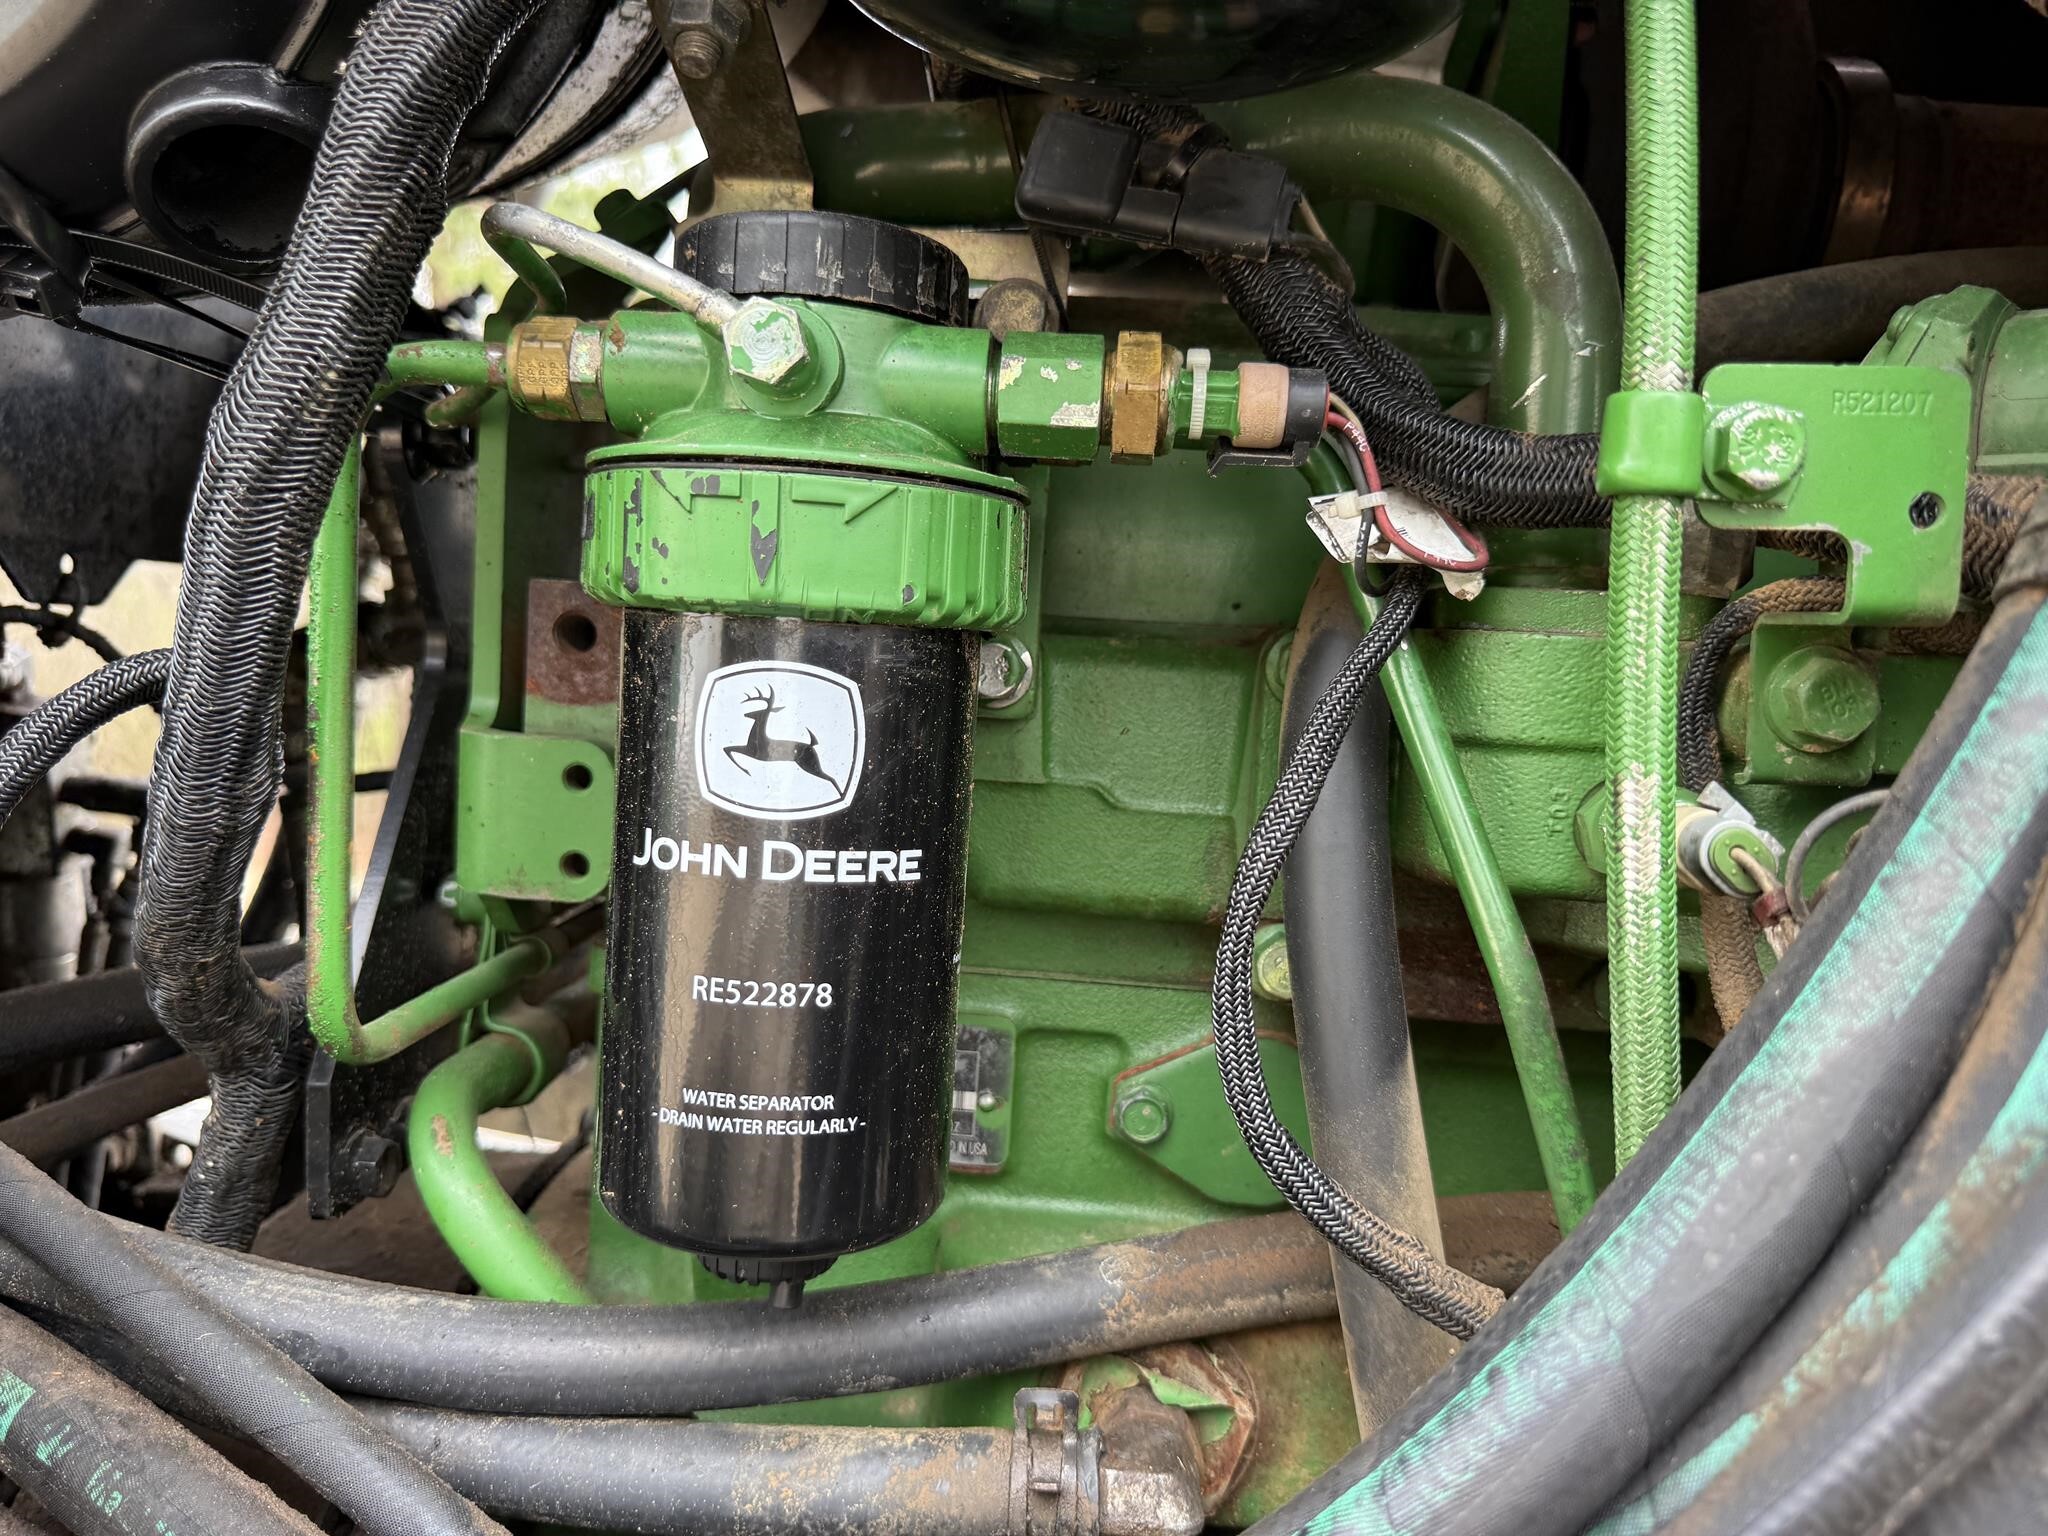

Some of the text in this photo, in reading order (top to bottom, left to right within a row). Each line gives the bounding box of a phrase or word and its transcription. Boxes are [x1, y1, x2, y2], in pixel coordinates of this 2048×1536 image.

[1832, 389, 1934, 416] R521207
[632, 827, 923, 883] JOHN DEERE
[692, 974, 833, 1008] RE522878
[682, 1087, 835, 1112] WATER SEPARATOR
[706, 1115, 763, 1136] WATER
